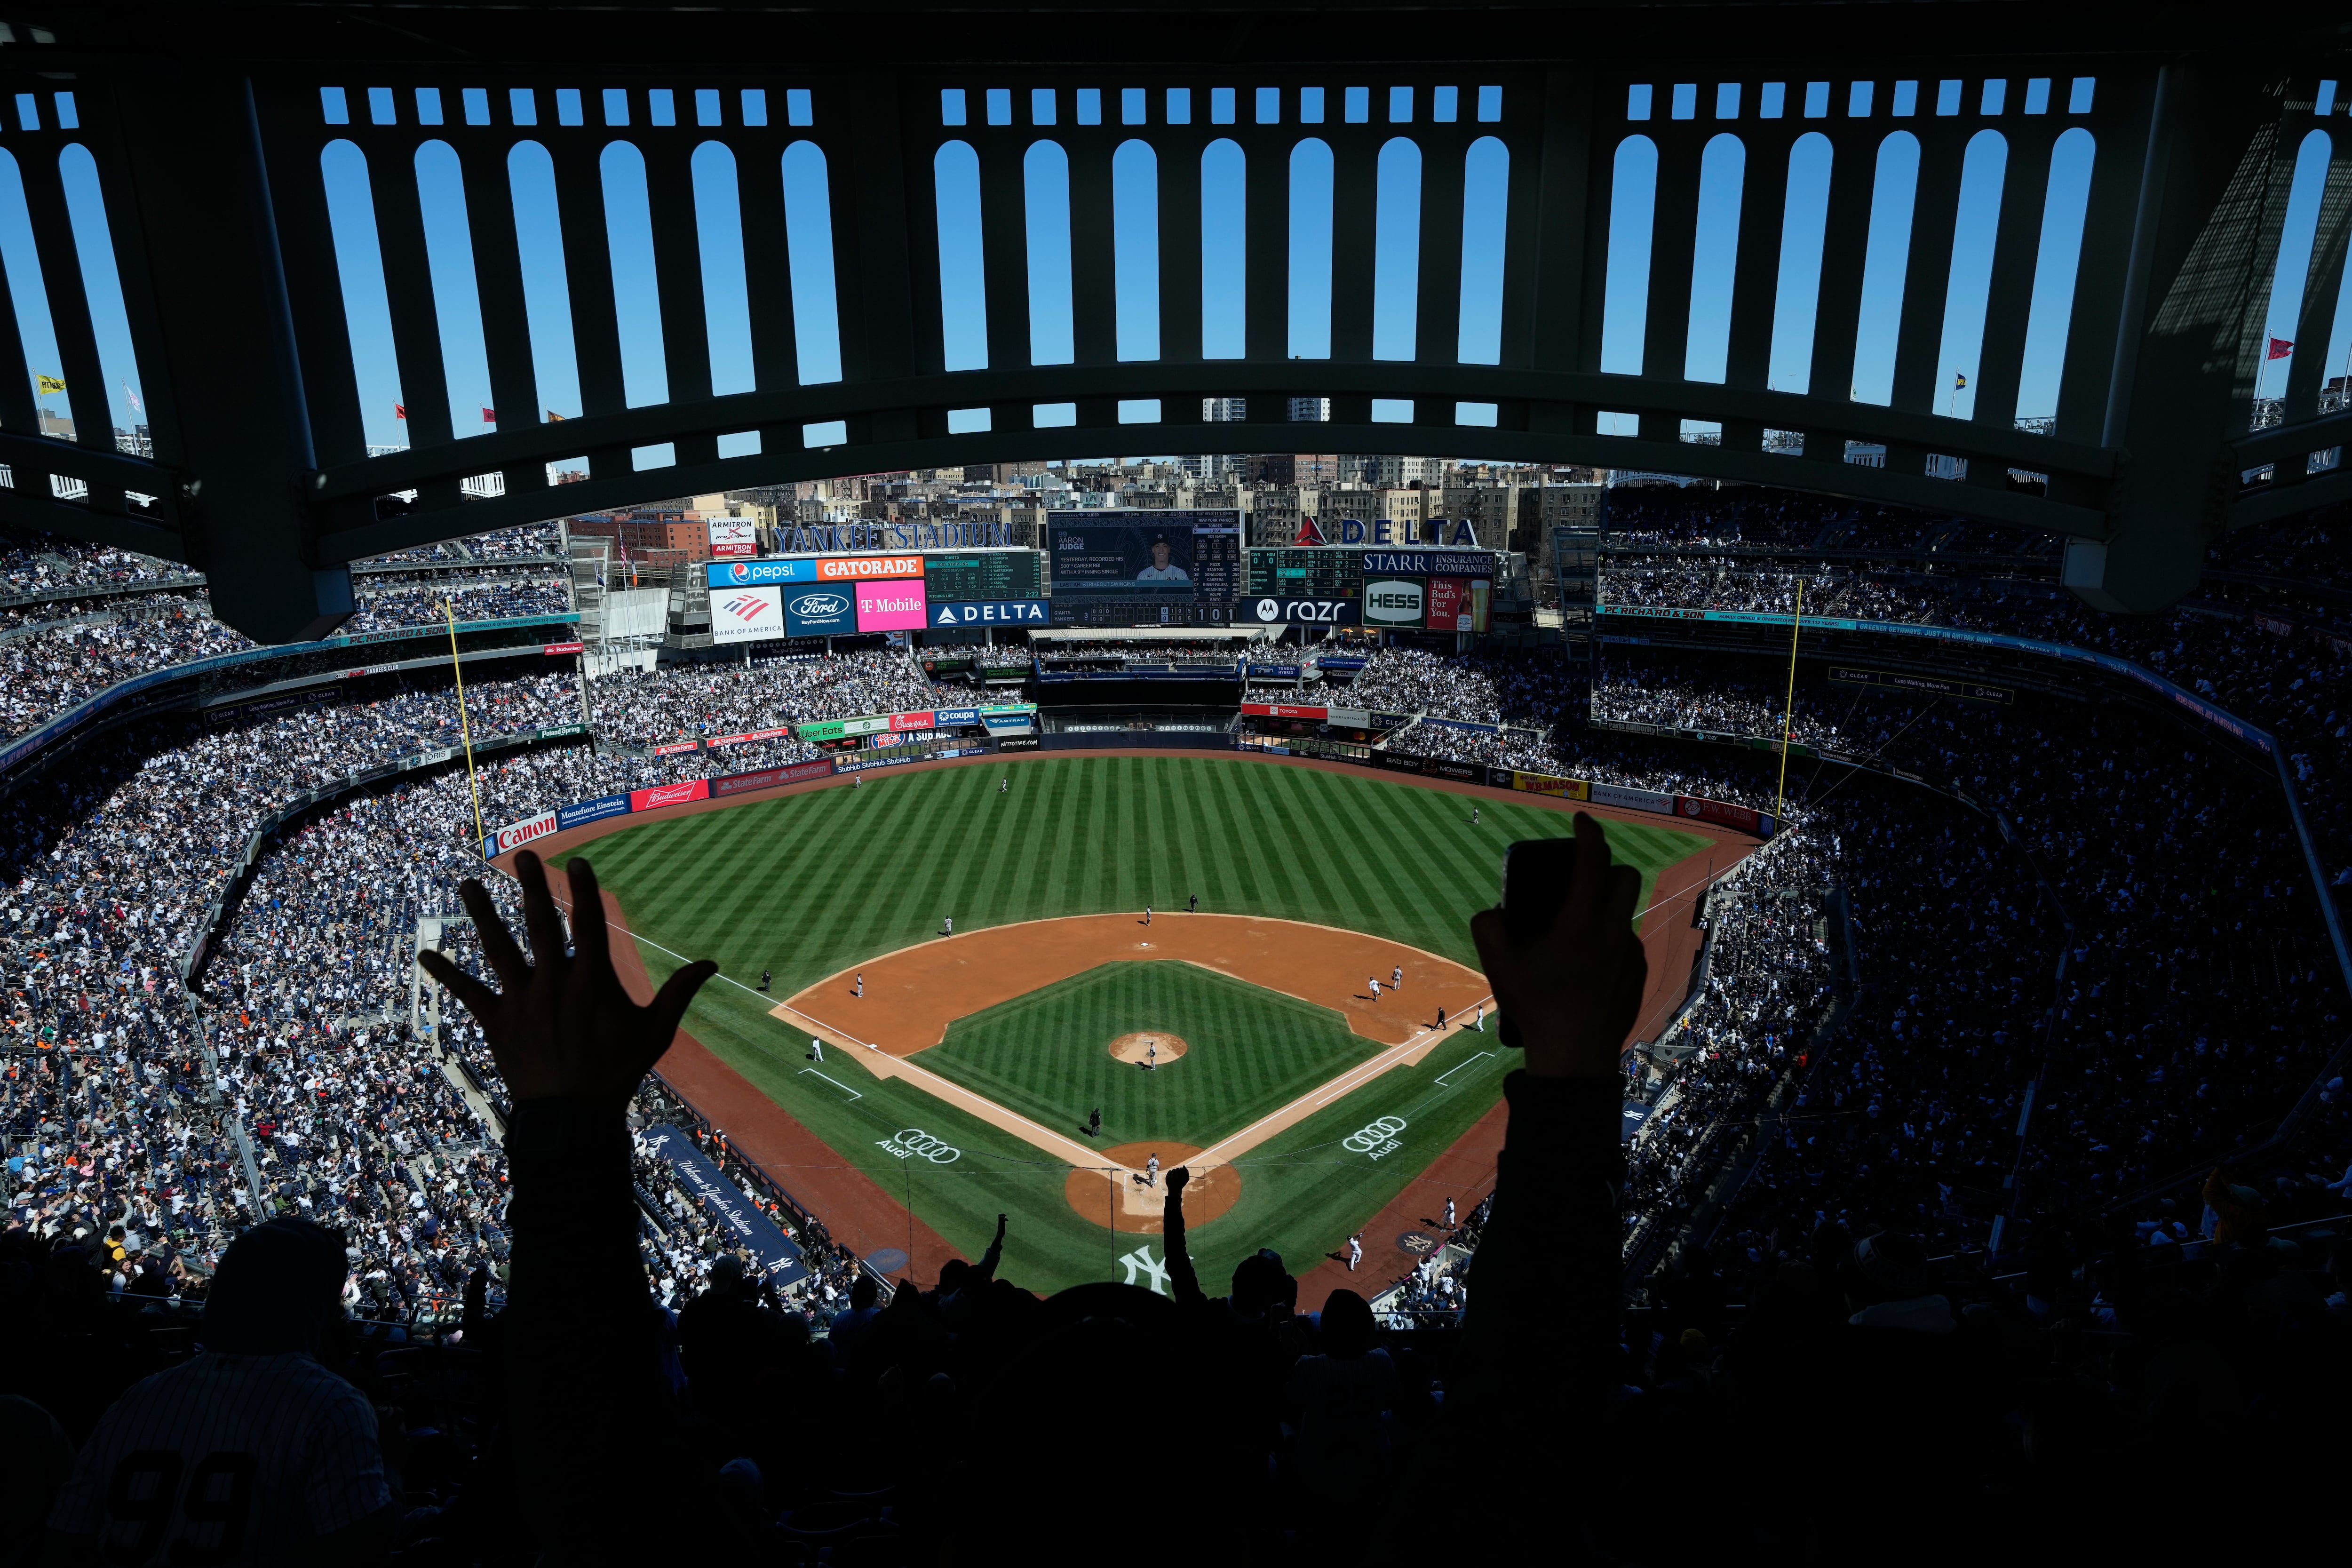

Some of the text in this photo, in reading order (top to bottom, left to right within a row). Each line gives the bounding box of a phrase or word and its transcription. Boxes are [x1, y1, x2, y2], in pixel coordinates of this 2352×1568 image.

[772, 523, 1012, 553] YANKEE STADIUM
[1343, 519, 1478, 546] DELTA
[824, 559, 917, 576] GATORADE
[1364, 553, 1428, 571] STARR
[1436, 555, 1493, 565] INSURANCE
[753, 564, 795, 581] pepsi
[1435, 564, 1493, 573] COMPANIES
[1431, 580, 1452, 589] This
[1369, 594, 1419, 609] HESS
[1432, 590, 1456, 599] Bud's
[801, 597, 838, 614] Ford
[876, 598, 922, 613] Mobile
[1431, 599, 1446, 608] For
[964, 604, 1043, 621] DELTA
[1199, 608, 1233, 621] 1 0 1
[1287, 602, 1345, 621] razr
[1431, 608, 1450, 617] You.
[1621, 607, 1671, 617] RICHARD
[349, 626, 446, 645] P.C. RICHARD & SON
[366, 667, 386, 675] YANKEES
[949, 712, 974, 721] coupa
[541, 726, 581, 739] Poland Spring
[801, 728, 821, 738] Uber
[823, 726, 842, 734] Eats
[908, 726, 962, 742] A SUB ABOVE
[1626, 724, 1656, 734] Authority
[1001, 739, 1038, 748] NITTOTIRE.COM
[427, 751, 446, 761] ORIS
[838, 757, 911, 773] StubHub StubHub StubHub
[1440, 765, 1473, 776] MOWERS
[649, 789, 691, 802] Budweiser
[1623, 795, 1654, 805] AMERICA
[561, 798, 624, 820] Montefiore Einstein
[1702, 803, 1752, 821] F.W. WEBB
[499, 816, 555, 849] Canon
[875, 1140, 913, 1159] Audi
[1368, 1138, 1403, 1161] Audi
[678, 1160, 753, 1236] Welcome to Yankee Stadium
[104, 1450, 258, 1567] 99
